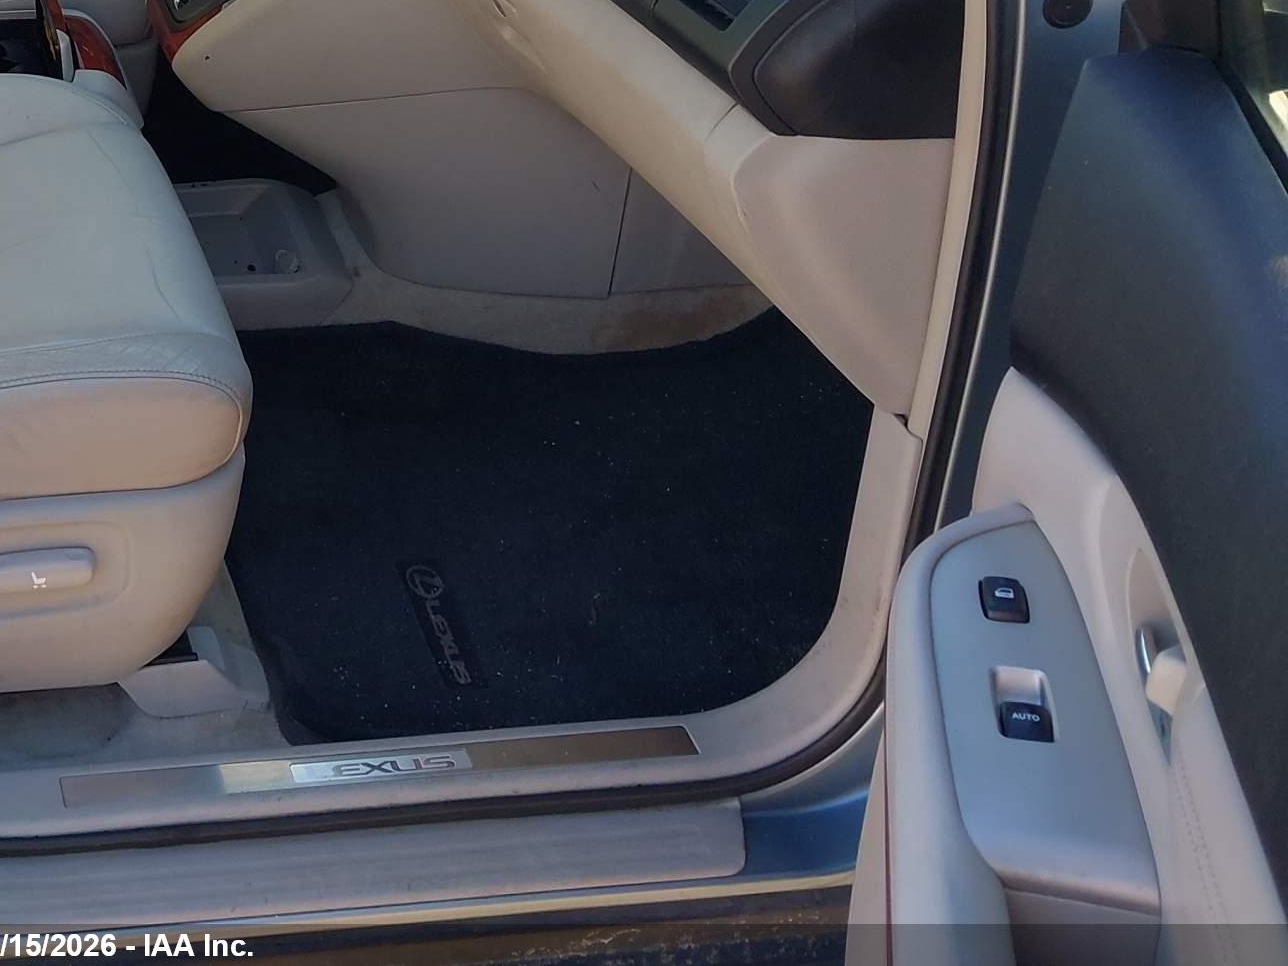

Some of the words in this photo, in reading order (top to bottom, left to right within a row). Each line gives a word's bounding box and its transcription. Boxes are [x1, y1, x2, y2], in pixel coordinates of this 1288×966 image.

[426, 599, 472, 684] LEXUS
[1012, 712, 1041, 722] AUTO
[312, 754, 456, 778] EXUS
